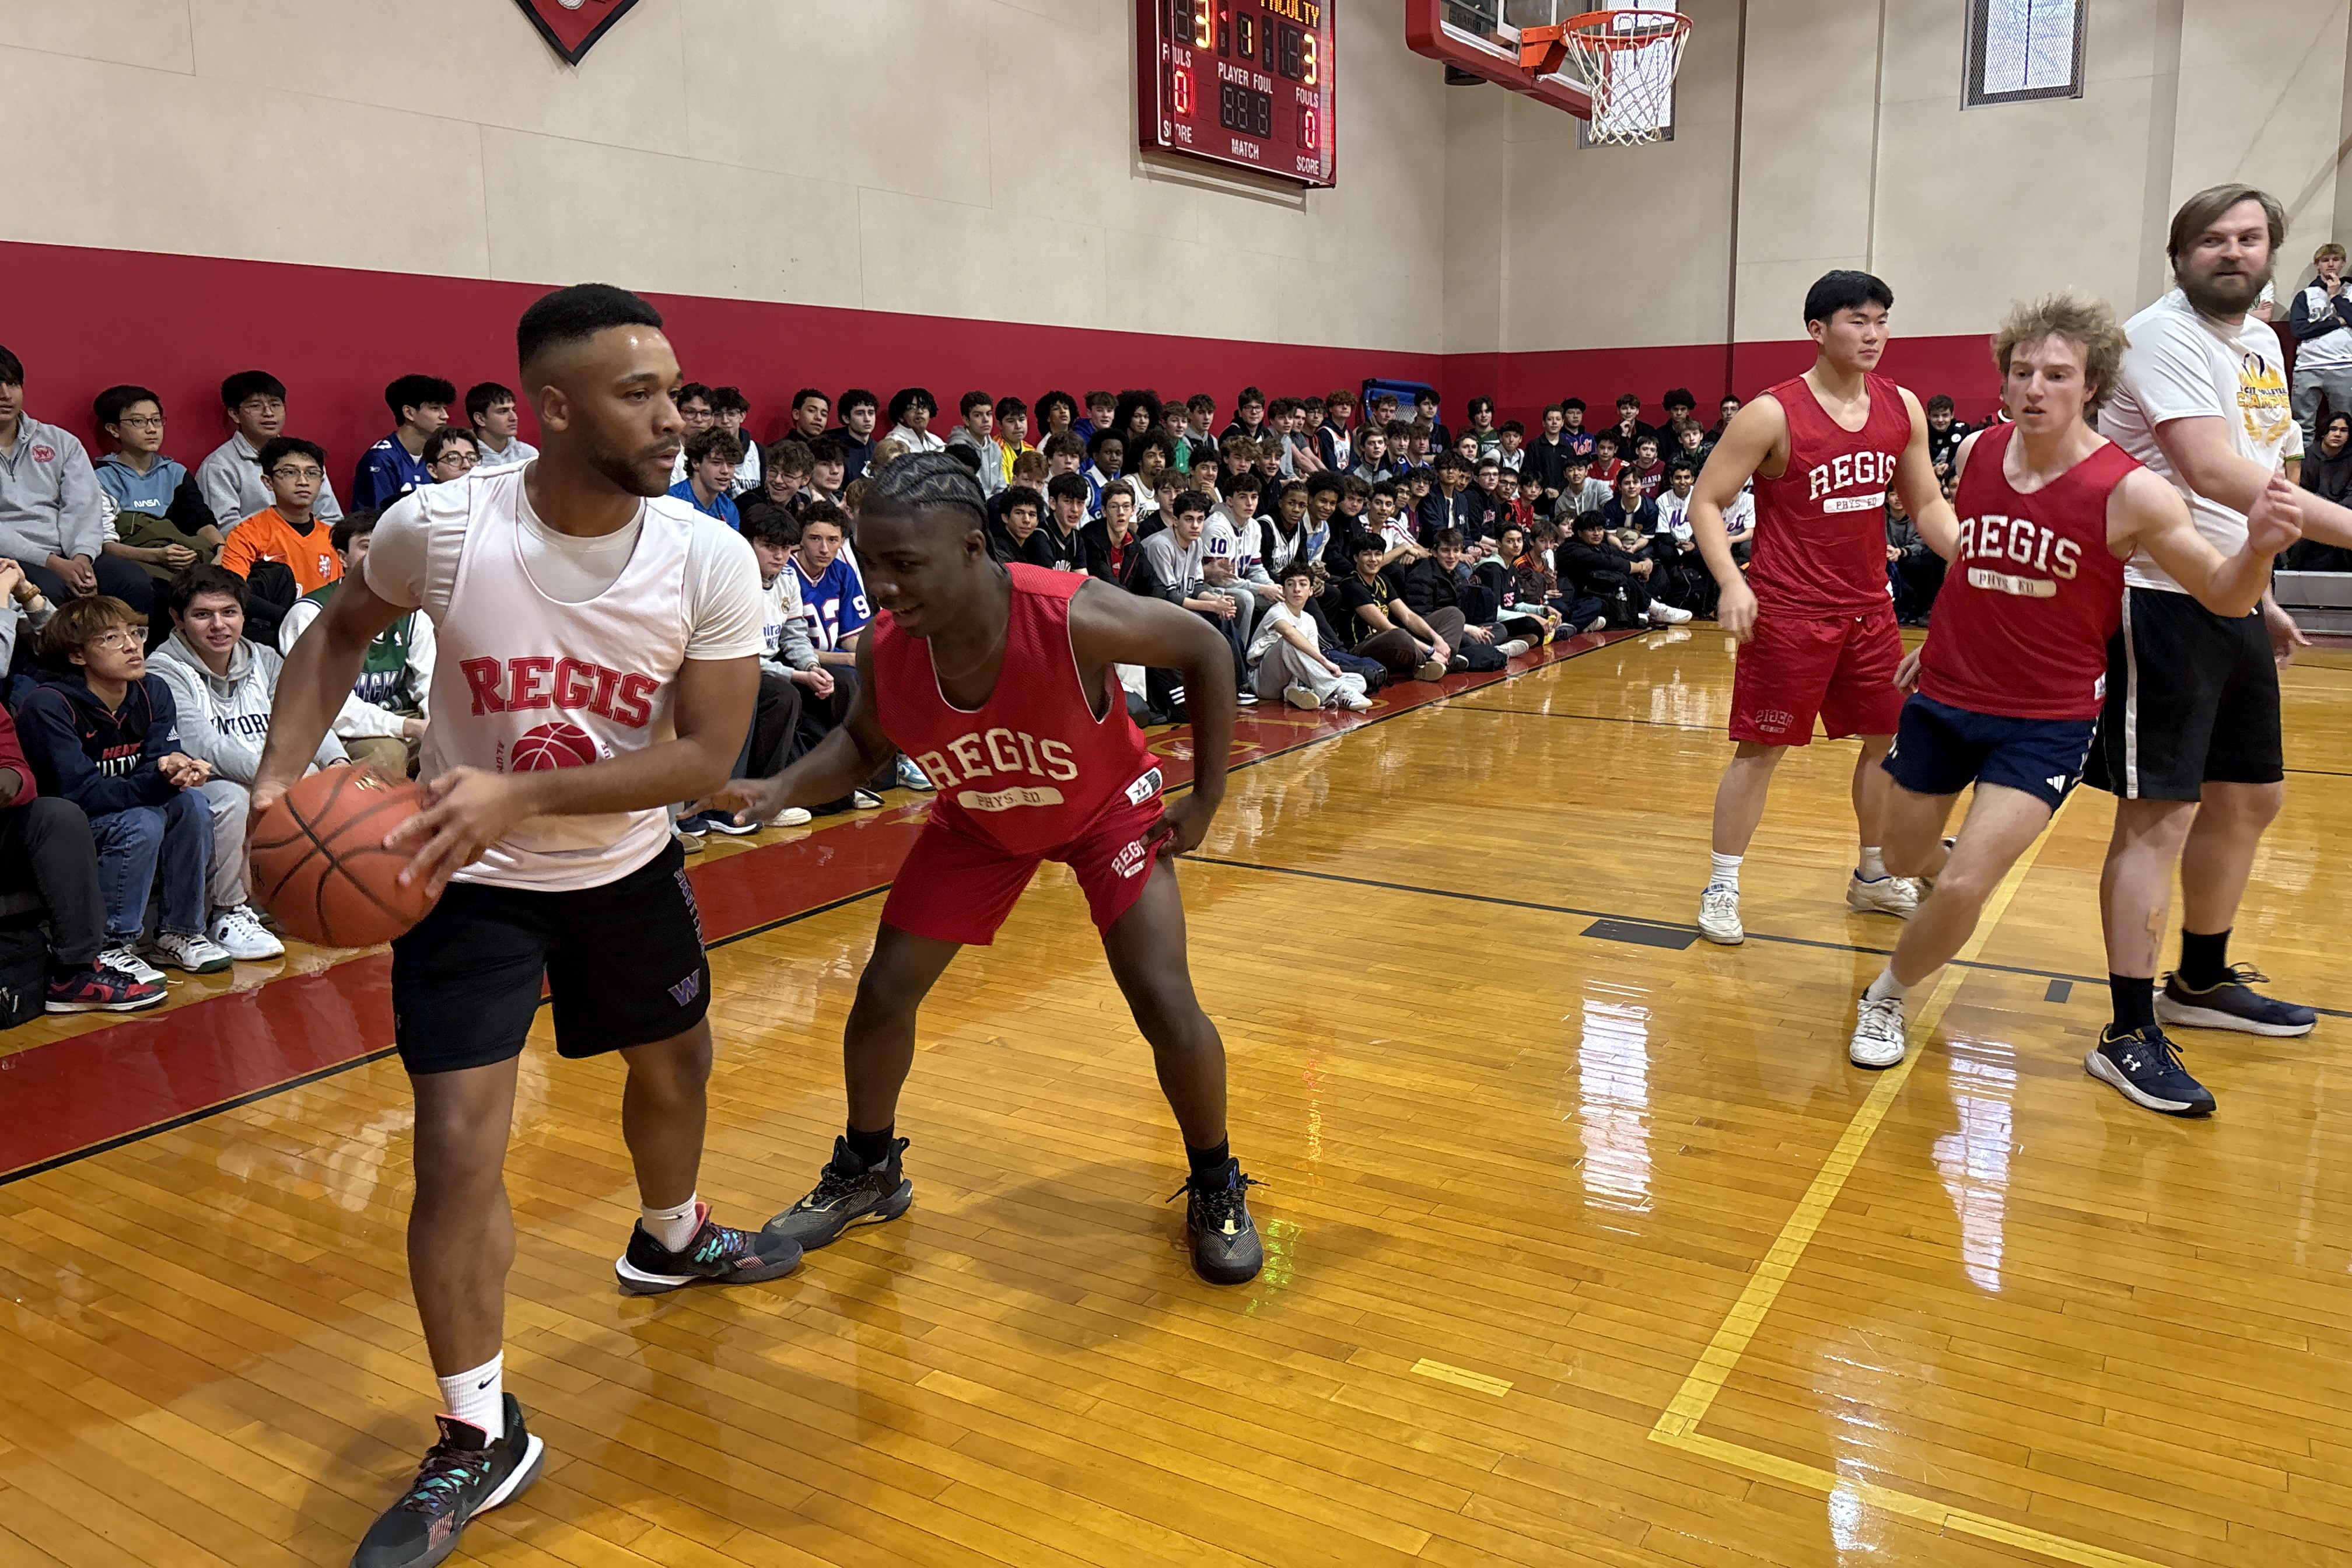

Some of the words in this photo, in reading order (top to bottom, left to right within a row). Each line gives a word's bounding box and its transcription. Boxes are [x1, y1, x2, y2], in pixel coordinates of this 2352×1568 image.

[1261, 0, 1319, 27] ACULTY
[1303, 33, 1317, 85] 3
[1174, 70, 1188, 113] 0
[1218, 61, 1249, 87] PLAYER
[1254, 73, 1273, 94] FOUL
[1296, 86, 1318, 108] FOULS
[1305, 110, 1315, 149] 0
[1231, 138, 1259, 160] MATCH
[1296, 155, 1320, 174] SCORE
[1809, 451, 1896, 501] REGIS
[134, 498, 161, 508] NASA
[1210, 538, 1227, 554] 10
[1960, 514, 2082, 580] REGIS
[852, 595, 871, 620] 9
[459, 656, 660, 729] REGIS
[915, 727, 1079, 791] REGIS
